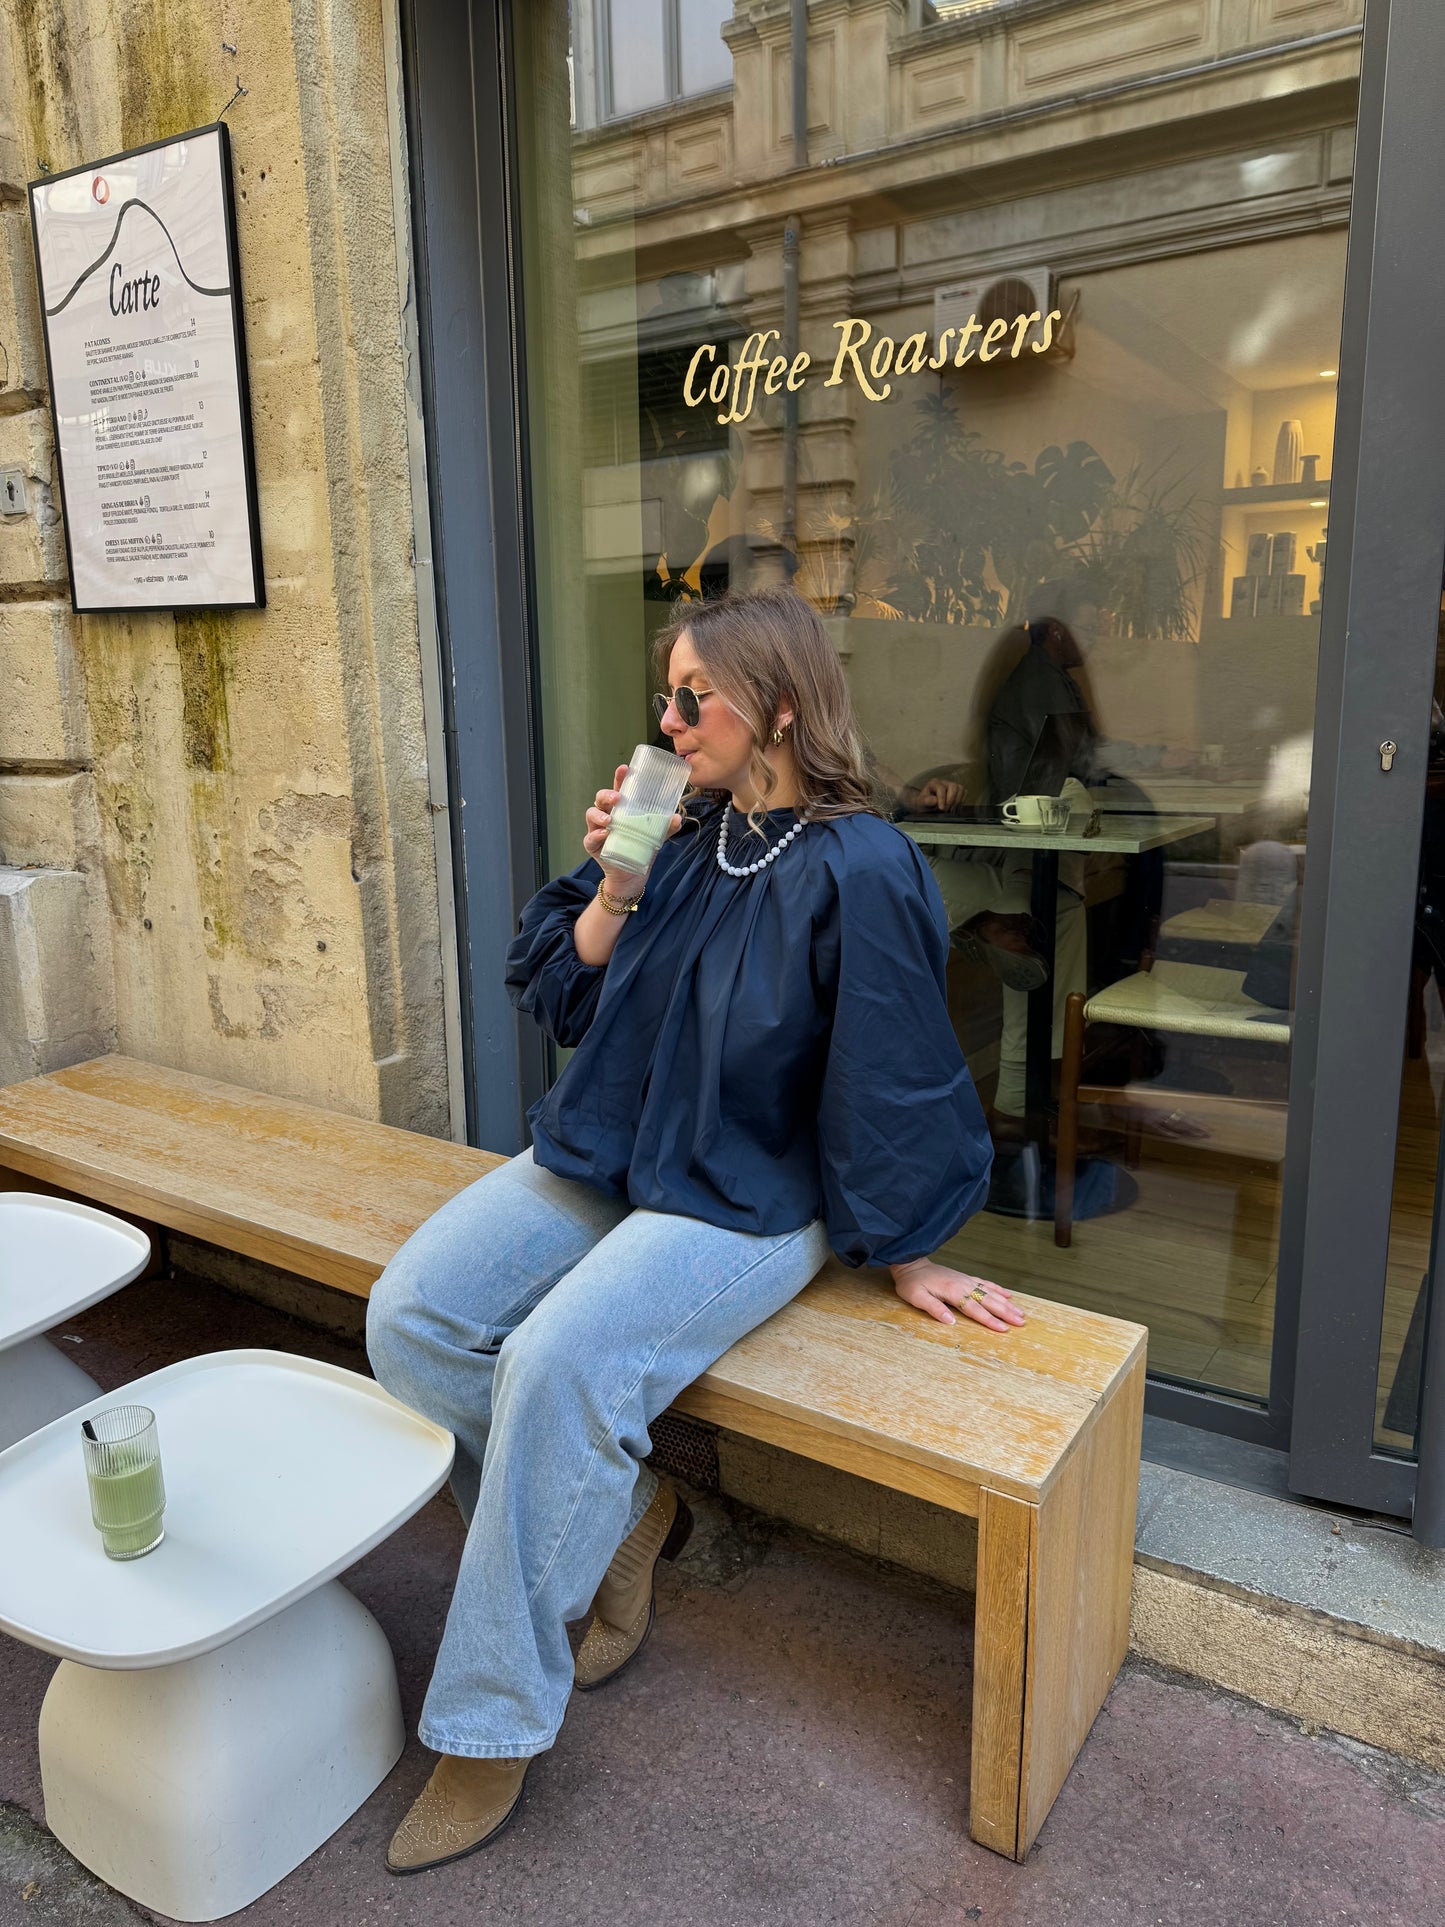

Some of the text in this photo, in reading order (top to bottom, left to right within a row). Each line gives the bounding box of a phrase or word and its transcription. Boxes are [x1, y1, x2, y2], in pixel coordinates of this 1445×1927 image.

[109, 262, 160, 316] Carte
[683, 309, 1062, 425] Coffee Roasters
